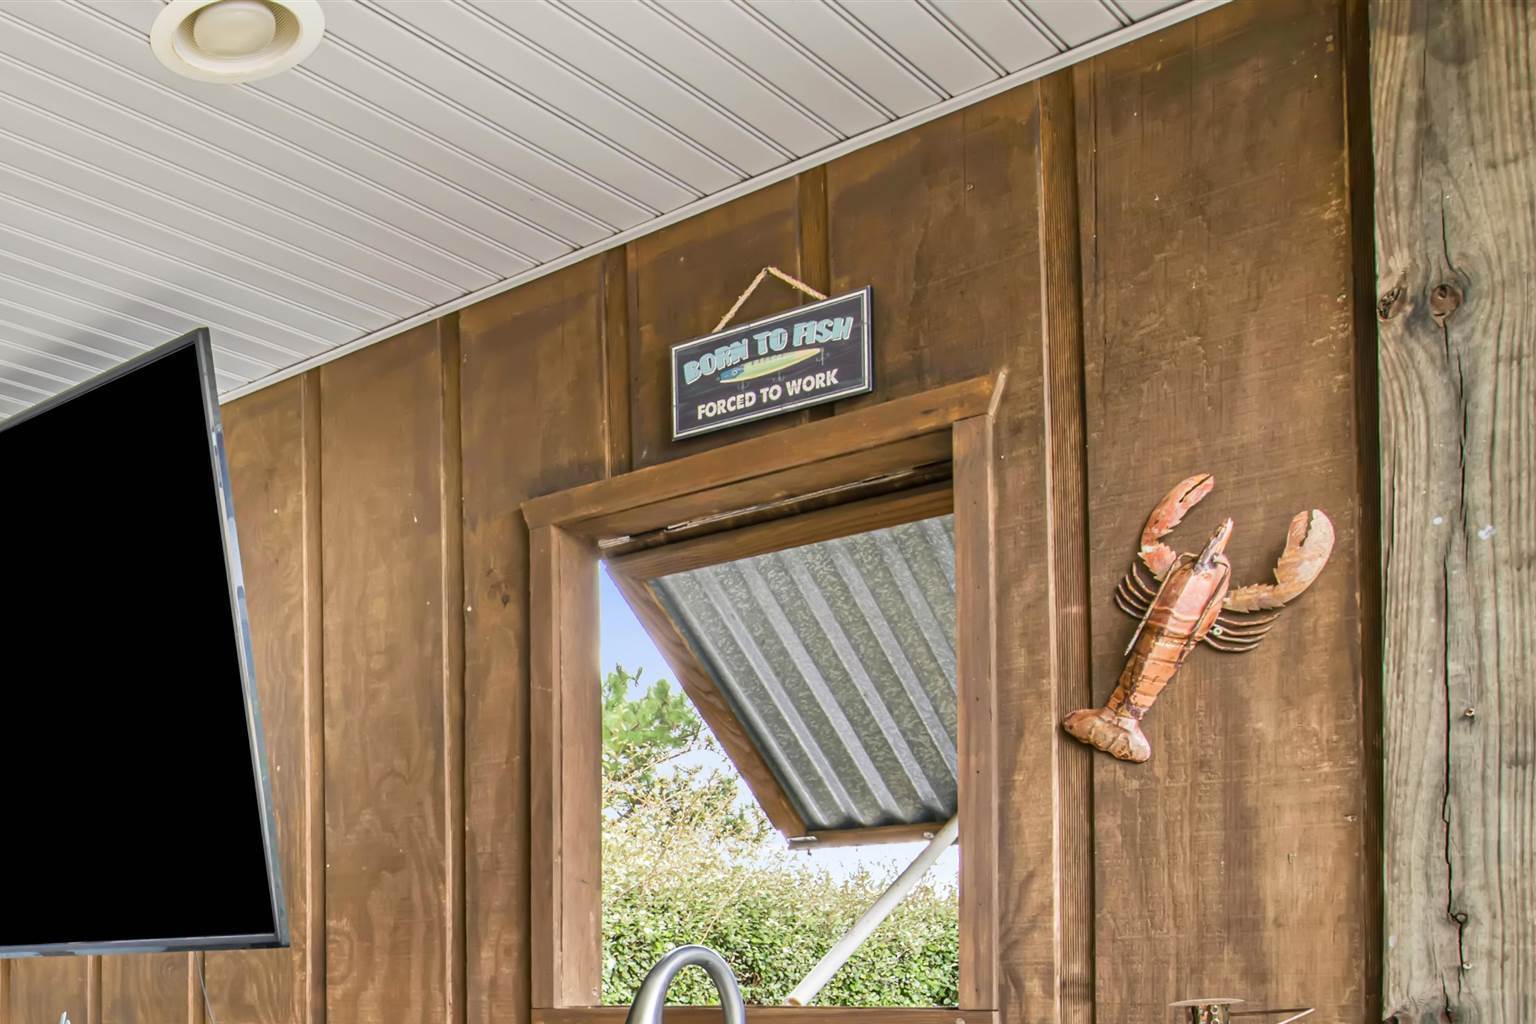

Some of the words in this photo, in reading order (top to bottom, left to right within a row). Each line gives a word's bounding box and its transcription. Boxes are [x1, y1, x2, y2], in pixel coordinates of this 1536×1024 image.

[683, 338, 749, 385] BORN
[753, 327, 788, 354] TO
[793, 317, 854, 347] FISH
[697, 392, 756, 420] FORCED
[760, 387, 781, 403] TO
[786, 369, 840, 397] WORK
